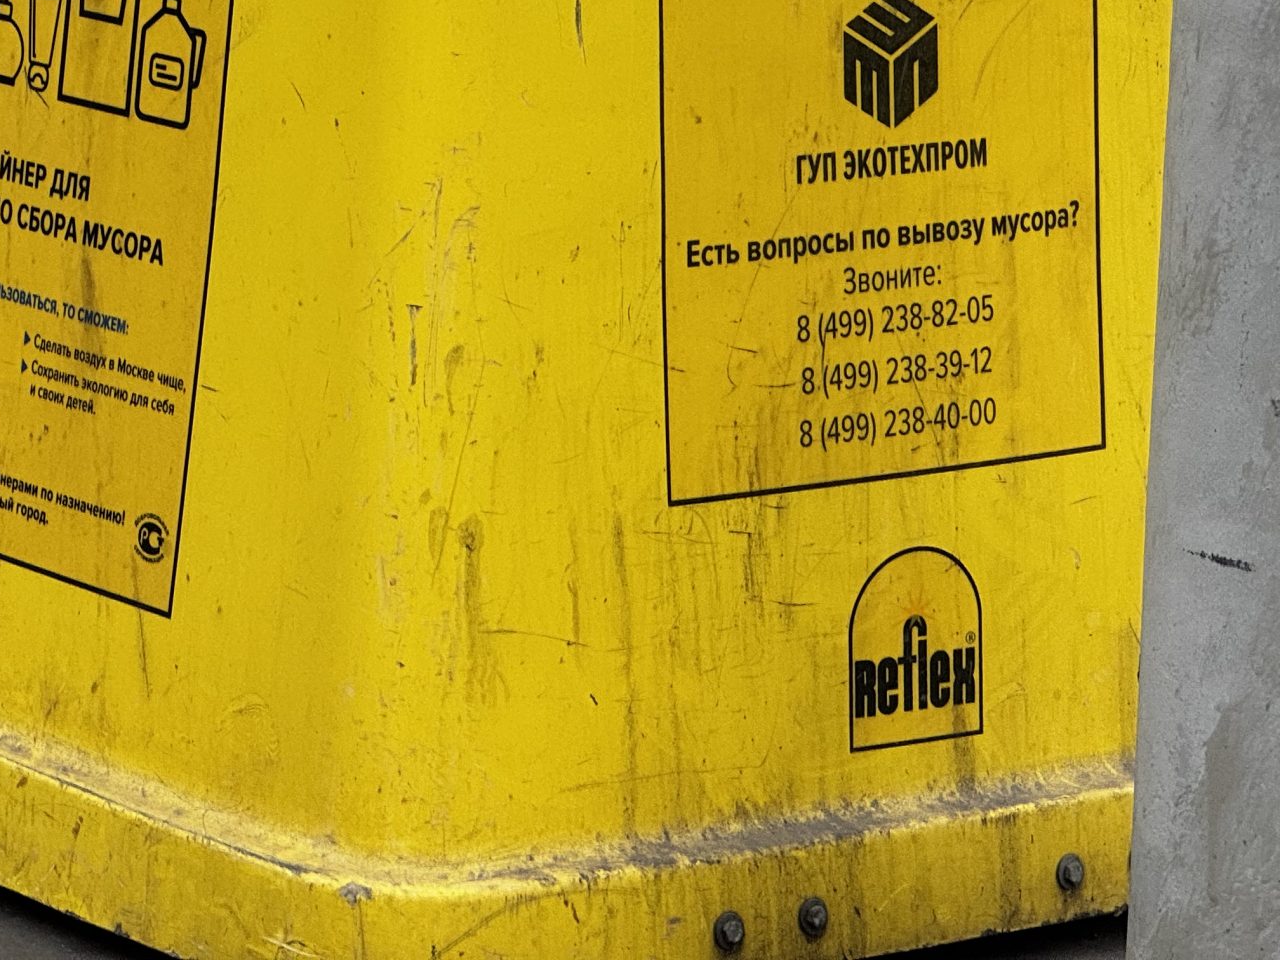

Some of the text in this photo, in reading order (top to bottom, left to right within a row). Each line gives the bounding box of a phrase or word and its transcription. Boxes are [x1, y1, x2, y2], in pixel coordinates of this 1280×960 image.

[49, 168, 92, 203] ДЛЯ
[795, 136, 988, 185] ГУП ЭКОТЕХПРОМ
[17, 203, 78, 244] СБОРА
[82, 219, 165, 267] МУСОРА
[686, 199, 1081, 269] Есть вопросы по вывозу мусора?
[842, 262, 943, 296] Звоните:
[62, 302, 76, 320] ТО
[77, 306, 130, 336] СМОЖЕМ:
[796, 294, 995, 347] 8 (499) 238-82-05
[31, 360, 175, 417] Сохранить экологию для себя
[34, 333, 187, 395] Сделать воздух в Москве чище,
[801, 345, 993, 400] 8 (499) 238-39-12
[30, 384, 96, 416] и своих детей.
[799, 397, 997, 453] 8 (499) 238-40-00
[16, 503, 49, 526] город.
[41, 487, 54, 502] по
[56, 491, 126, 526] назначению!
